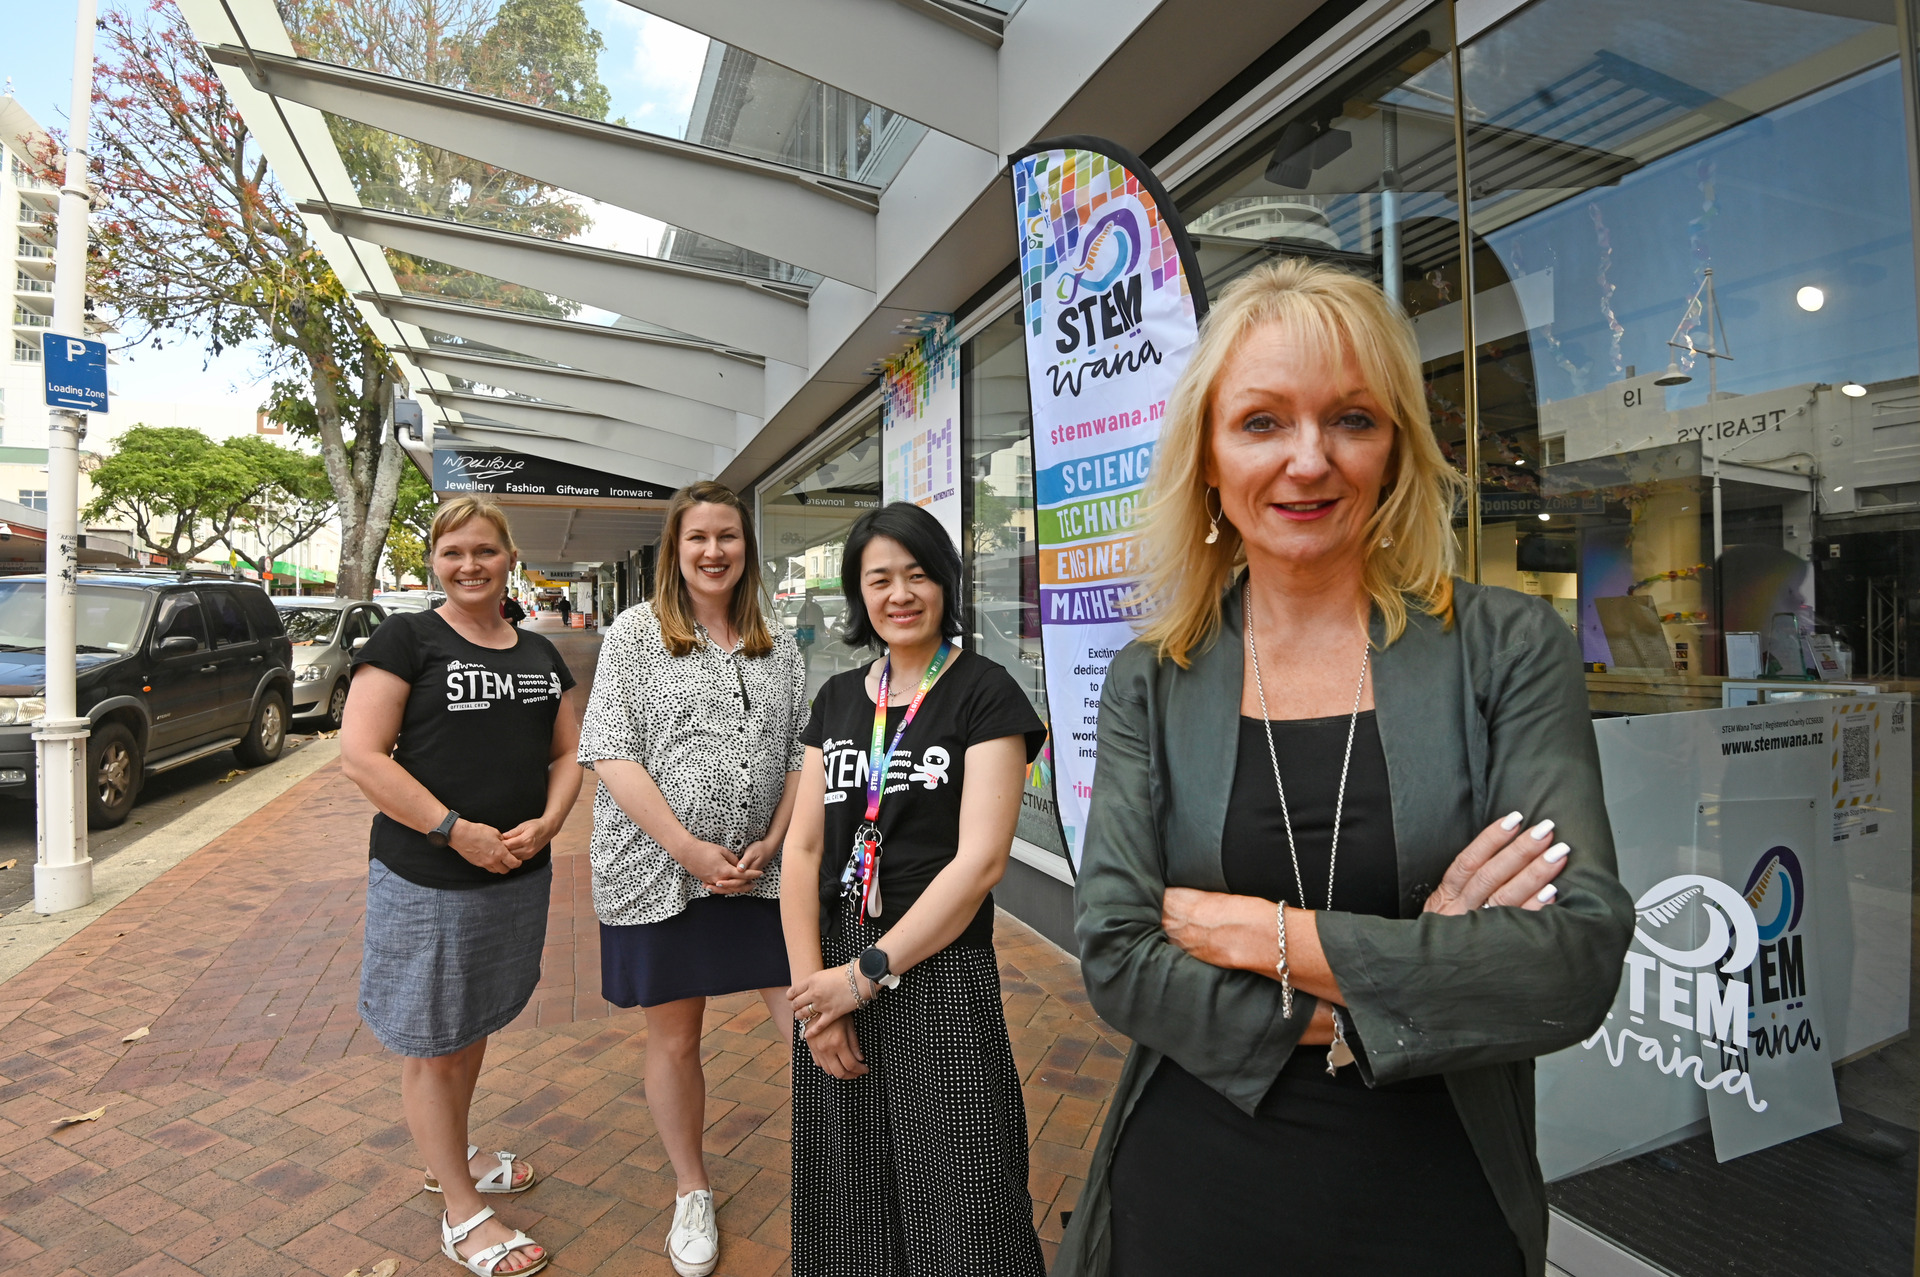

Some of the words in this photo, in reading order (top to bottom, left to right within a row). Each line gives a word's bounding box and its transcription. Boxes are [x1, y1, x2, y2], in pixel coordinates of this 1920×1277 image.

[1055, 272, 1143, 355] STEM
[66, 338, 87, 362] P
[48, 382, 83, 397] Loading
[85, 387, 106, 399] Zone
[1050, 400, 1167, 446] stemwana.nz
[887, 418, 953, 503] STEM
[444, 480, 494, 493] Jewellery
[506, 482, 545, 493] Fashion
[556, 484, 599, 496] Giftware
[609, 487, 653, 498] Ironware
[1056, 492, 1150, 539] TECHNOL
[1480, 498, 1541, 513] ponsors
[1545, 497, 1577, 509] Zone
[446, 671, 515, 701] STEM
[1090, 681, 1099, 692] to
[909, 690, 924, 713] TRUST
[874, 725, 884, 748] TRUST
[1721, 731, 1824, 756] www.stemwana.nz
[823, 749, 871, 790] TEM
[870, 770, 880, 792] STEM
